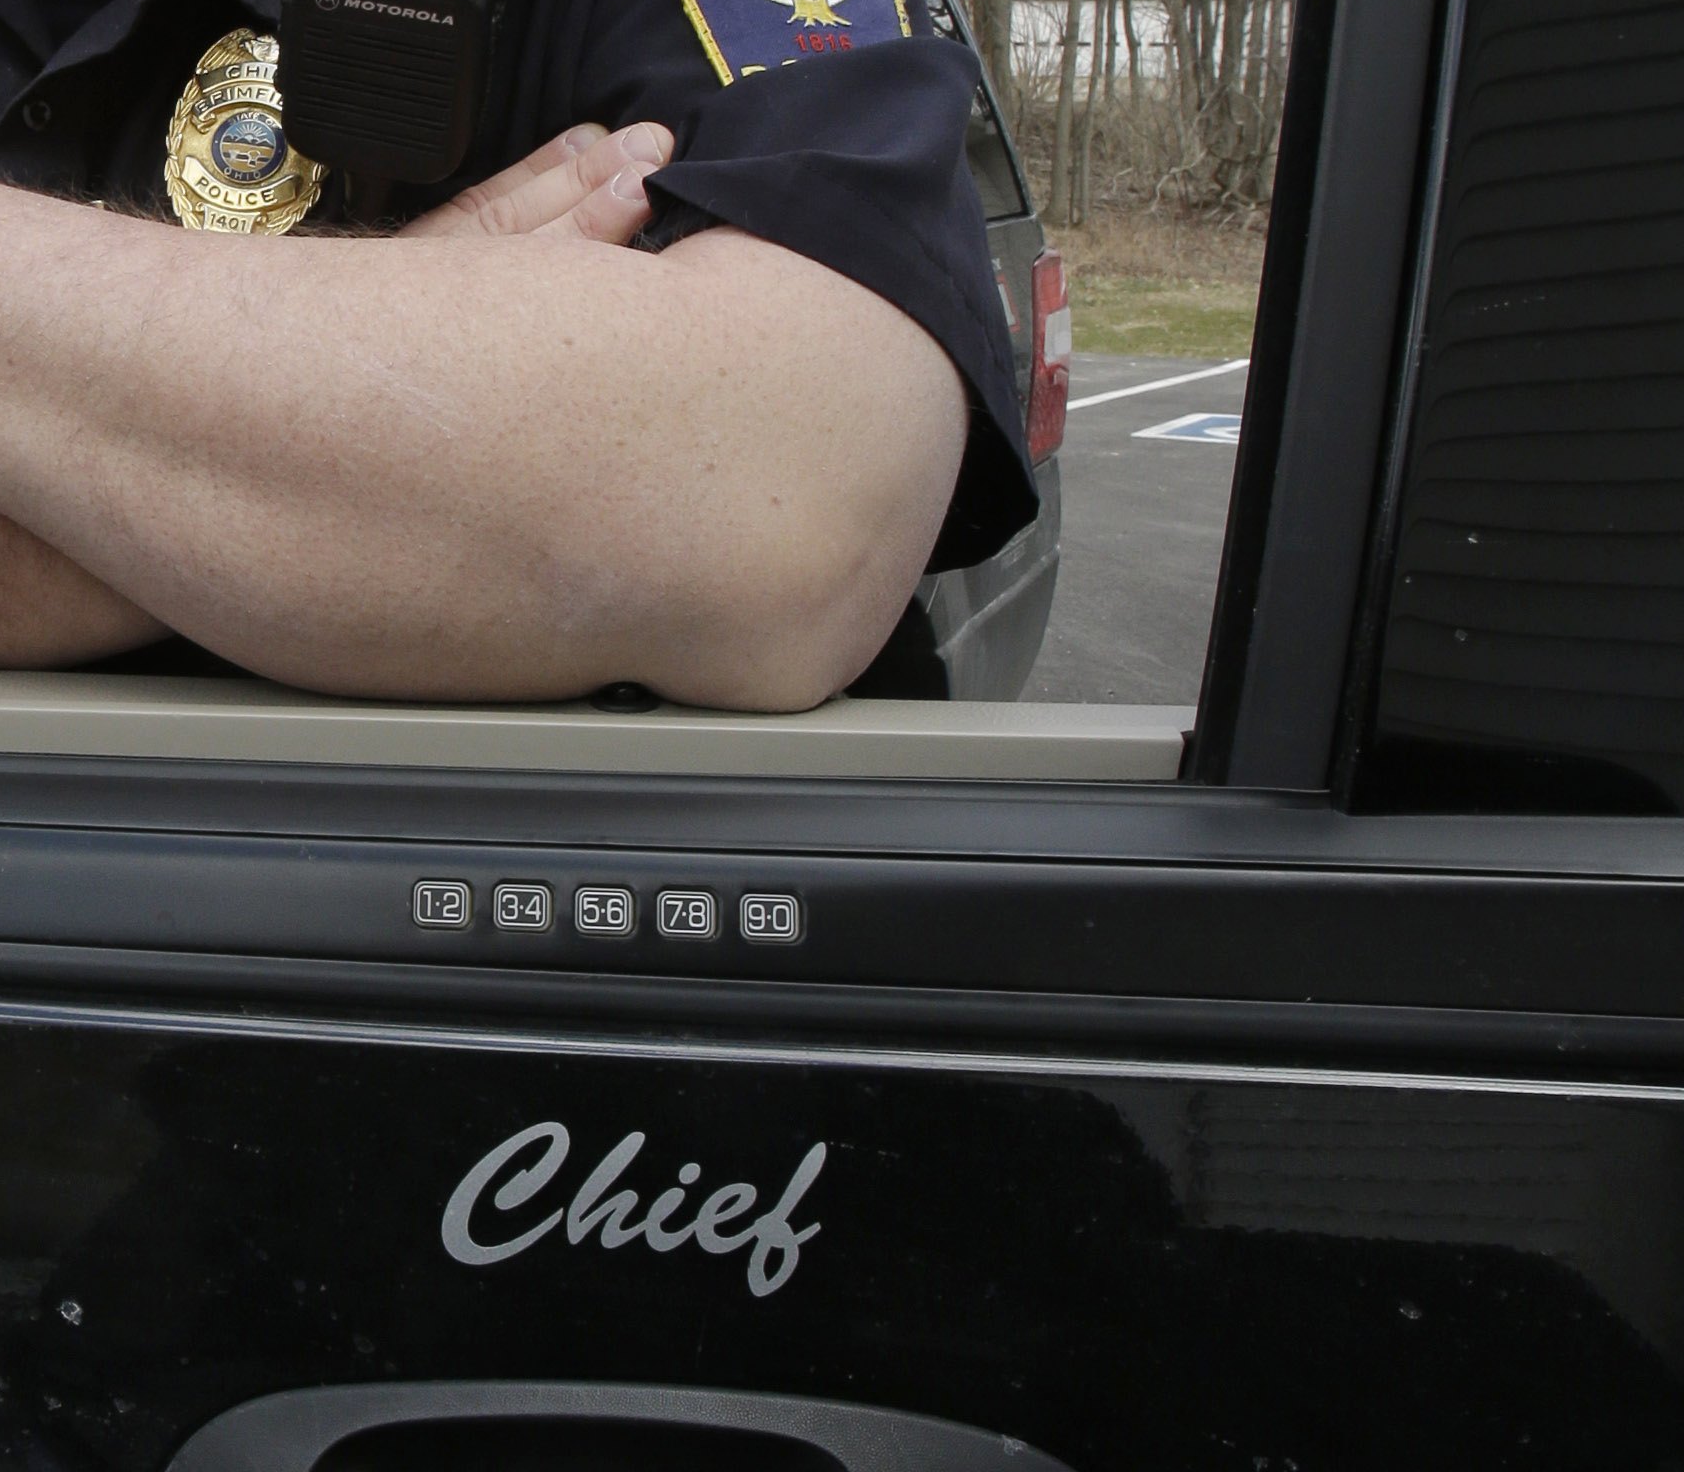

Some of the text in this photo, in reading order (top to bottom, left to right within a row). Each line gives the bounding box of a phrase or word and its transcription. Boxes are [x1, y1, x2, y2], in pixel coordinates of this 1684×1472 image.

[225, 64, 278, 80] CHI
[195, 176, 279, 206] POLICE
[209, 212, 248, 232] 1401
[440, 1121, 827, 1298] Chief
